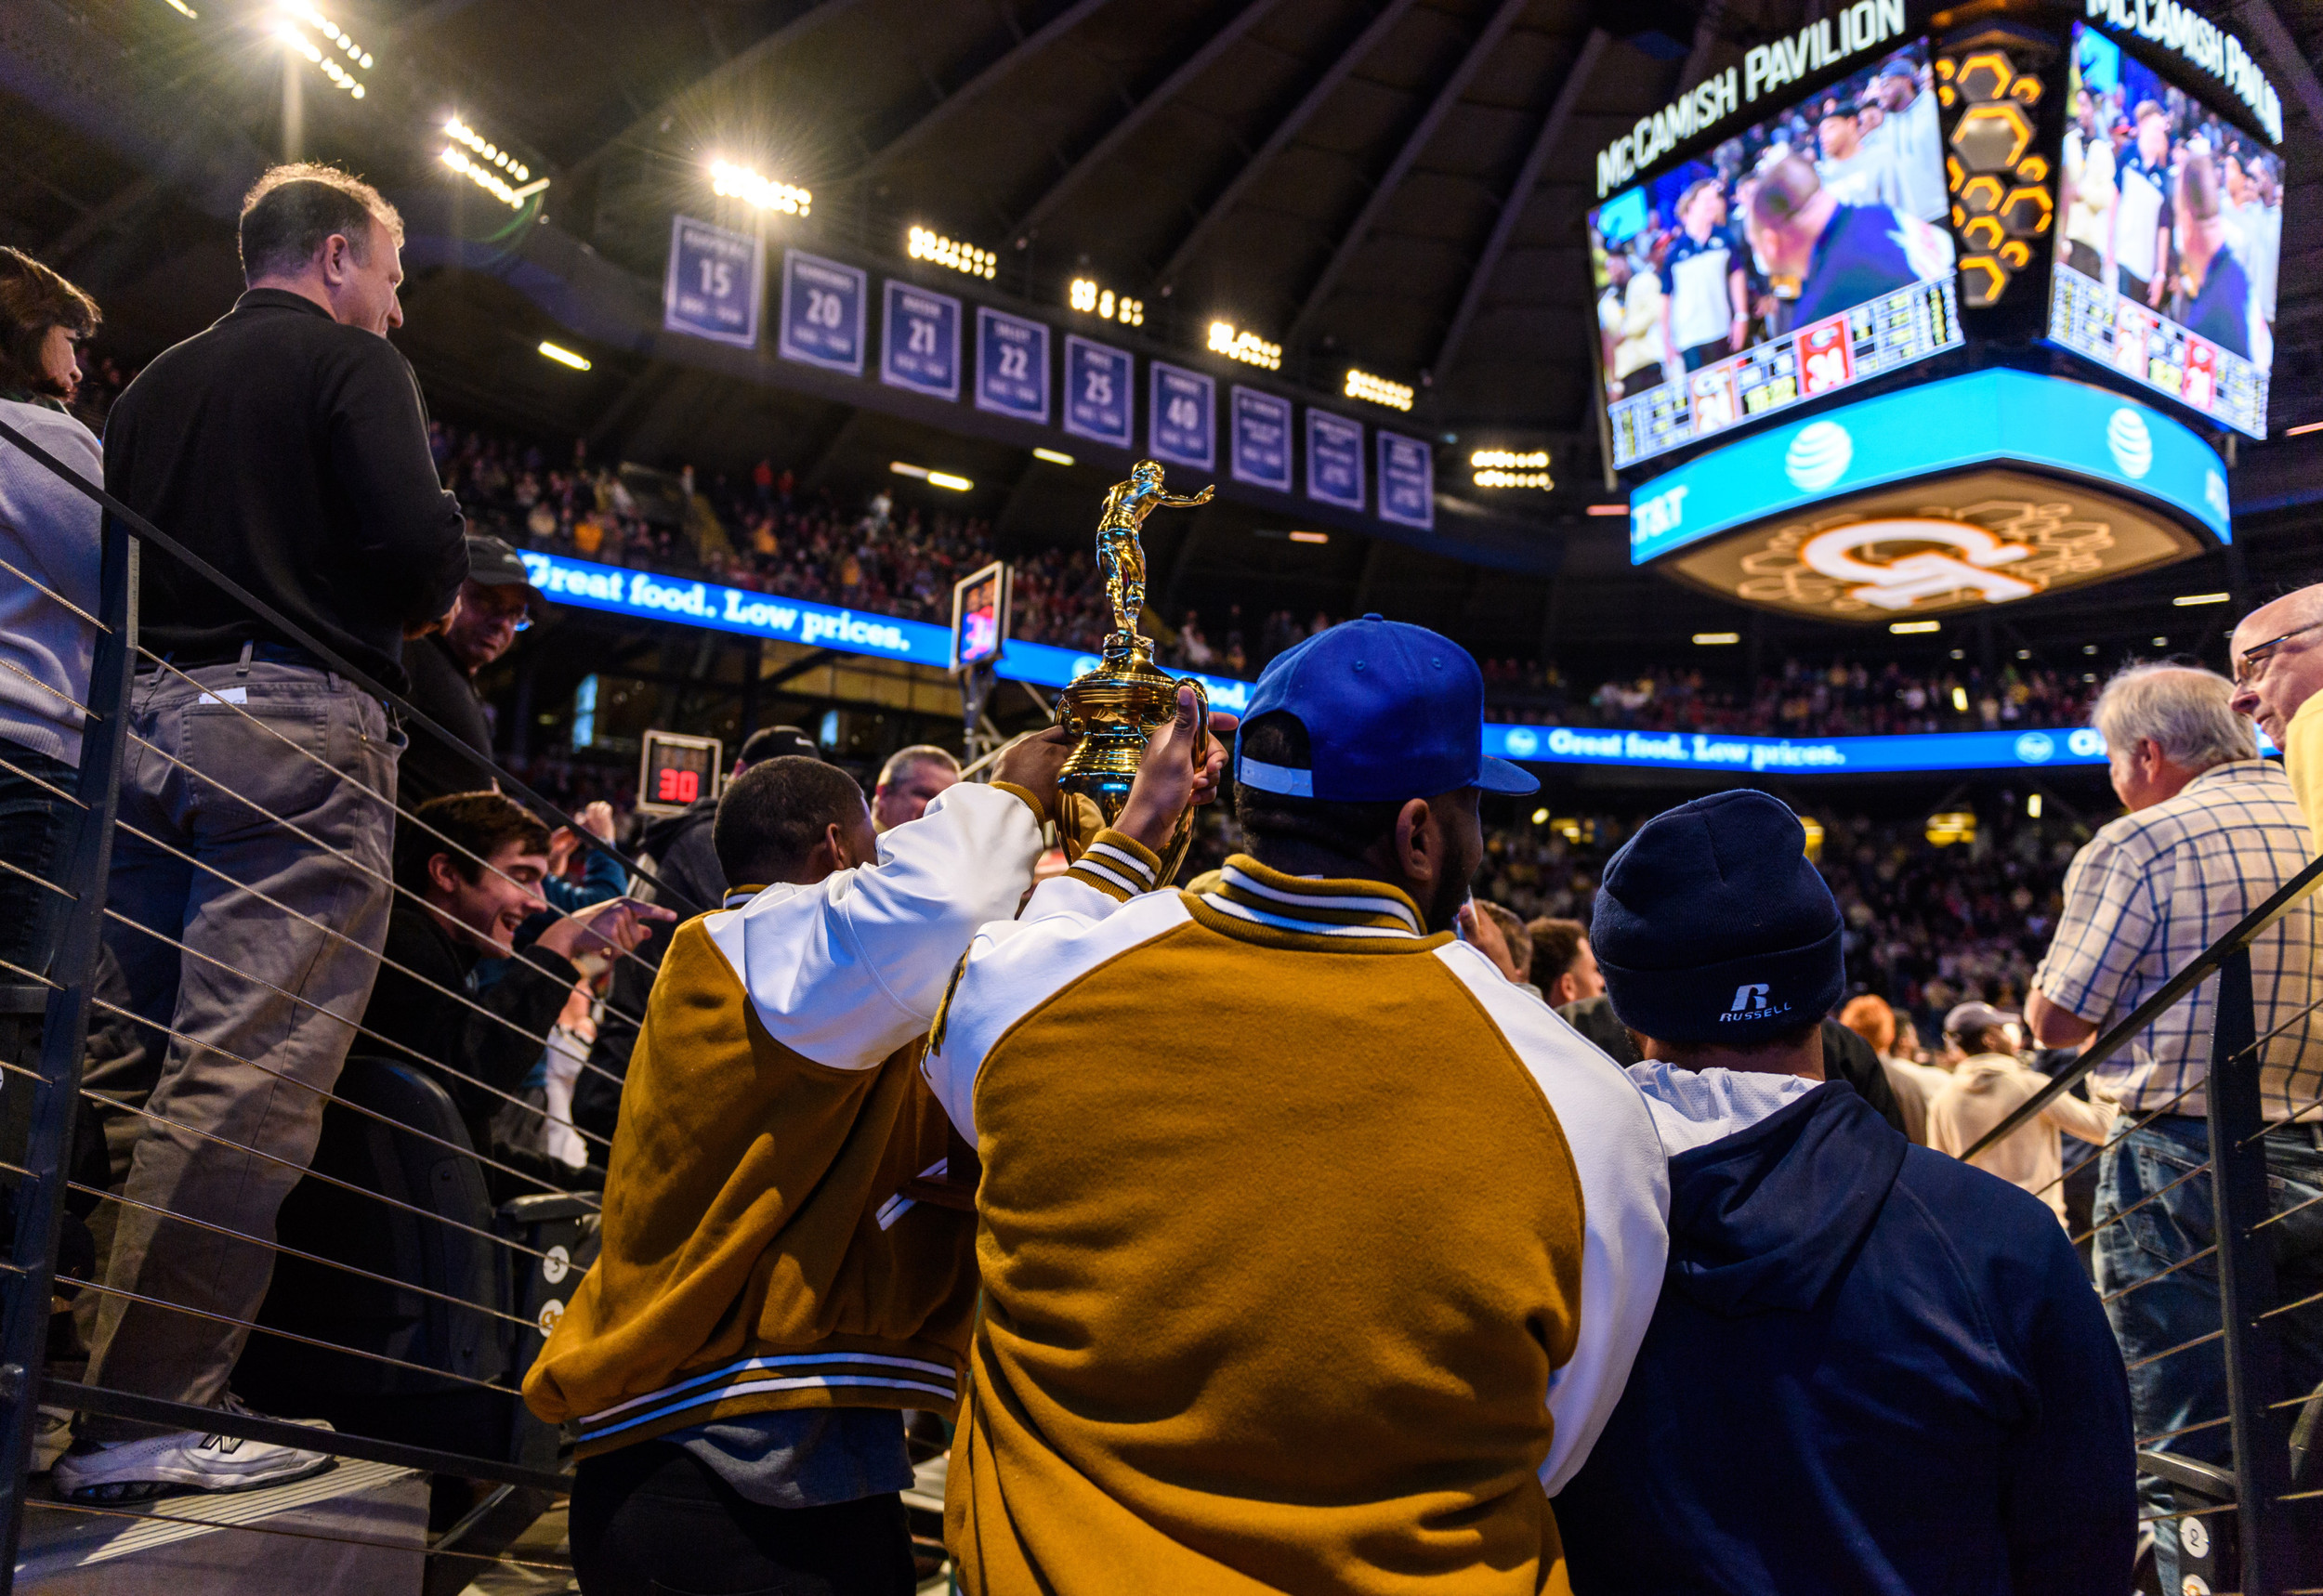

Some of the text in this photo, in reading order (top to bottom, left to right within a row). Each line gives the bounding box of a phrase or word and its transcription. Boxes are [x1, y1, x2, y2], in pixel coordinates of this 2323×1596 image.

[1744, 0, 1906, 102] PAVILION
[699, 258, 731, 298] 15
[806, 288, 843, 328] 20
[909, 319, 936, 355] 21
[999, 344, 1028, 381] 22
[1631, 485, 1688, 546] T&T
[629, 573, 717, 619] food.
[723, 589, 798, 632] Low
[800, 609, 911, 652] prices.
[1692, 734, 1750, 763] Low
[658, 767, 699, 803] 30
[1719, 1001, 1792, 1023] RUSSELL
